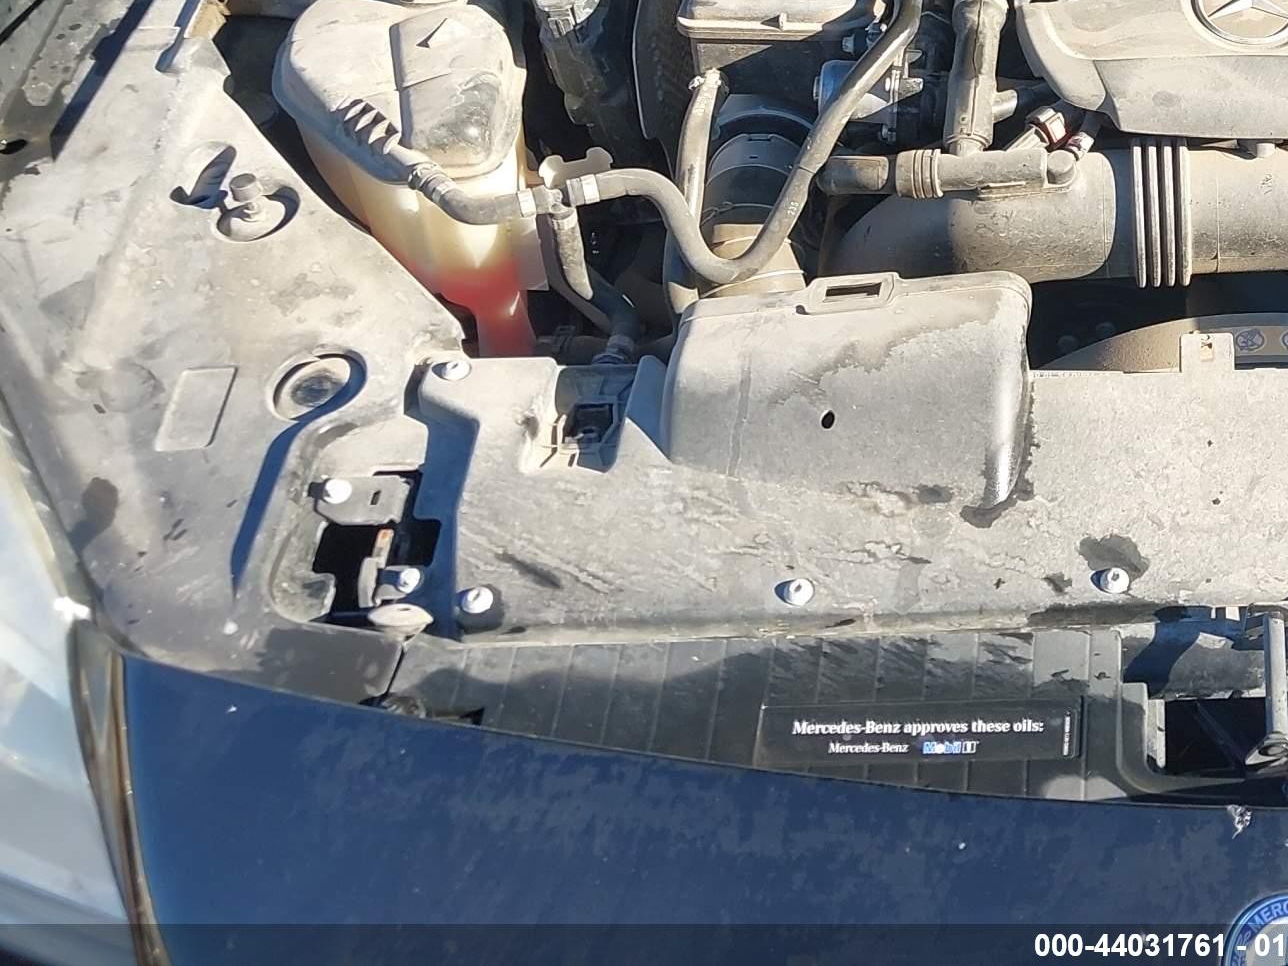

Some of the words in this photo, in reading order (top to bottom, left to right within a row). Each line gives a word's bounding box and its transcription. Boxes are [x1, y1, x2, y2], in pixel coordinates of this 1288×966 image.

[792, 719, 901, 735] Mercedes-Benz
[903, 721, 968, 736] approves
[971, 718, 1010, 733] these
[1012, 718, 1044, 733] oils:
[828, 741, 910, 754] Mercedes-Benz
[923, 741, 962, 754] Mobil
